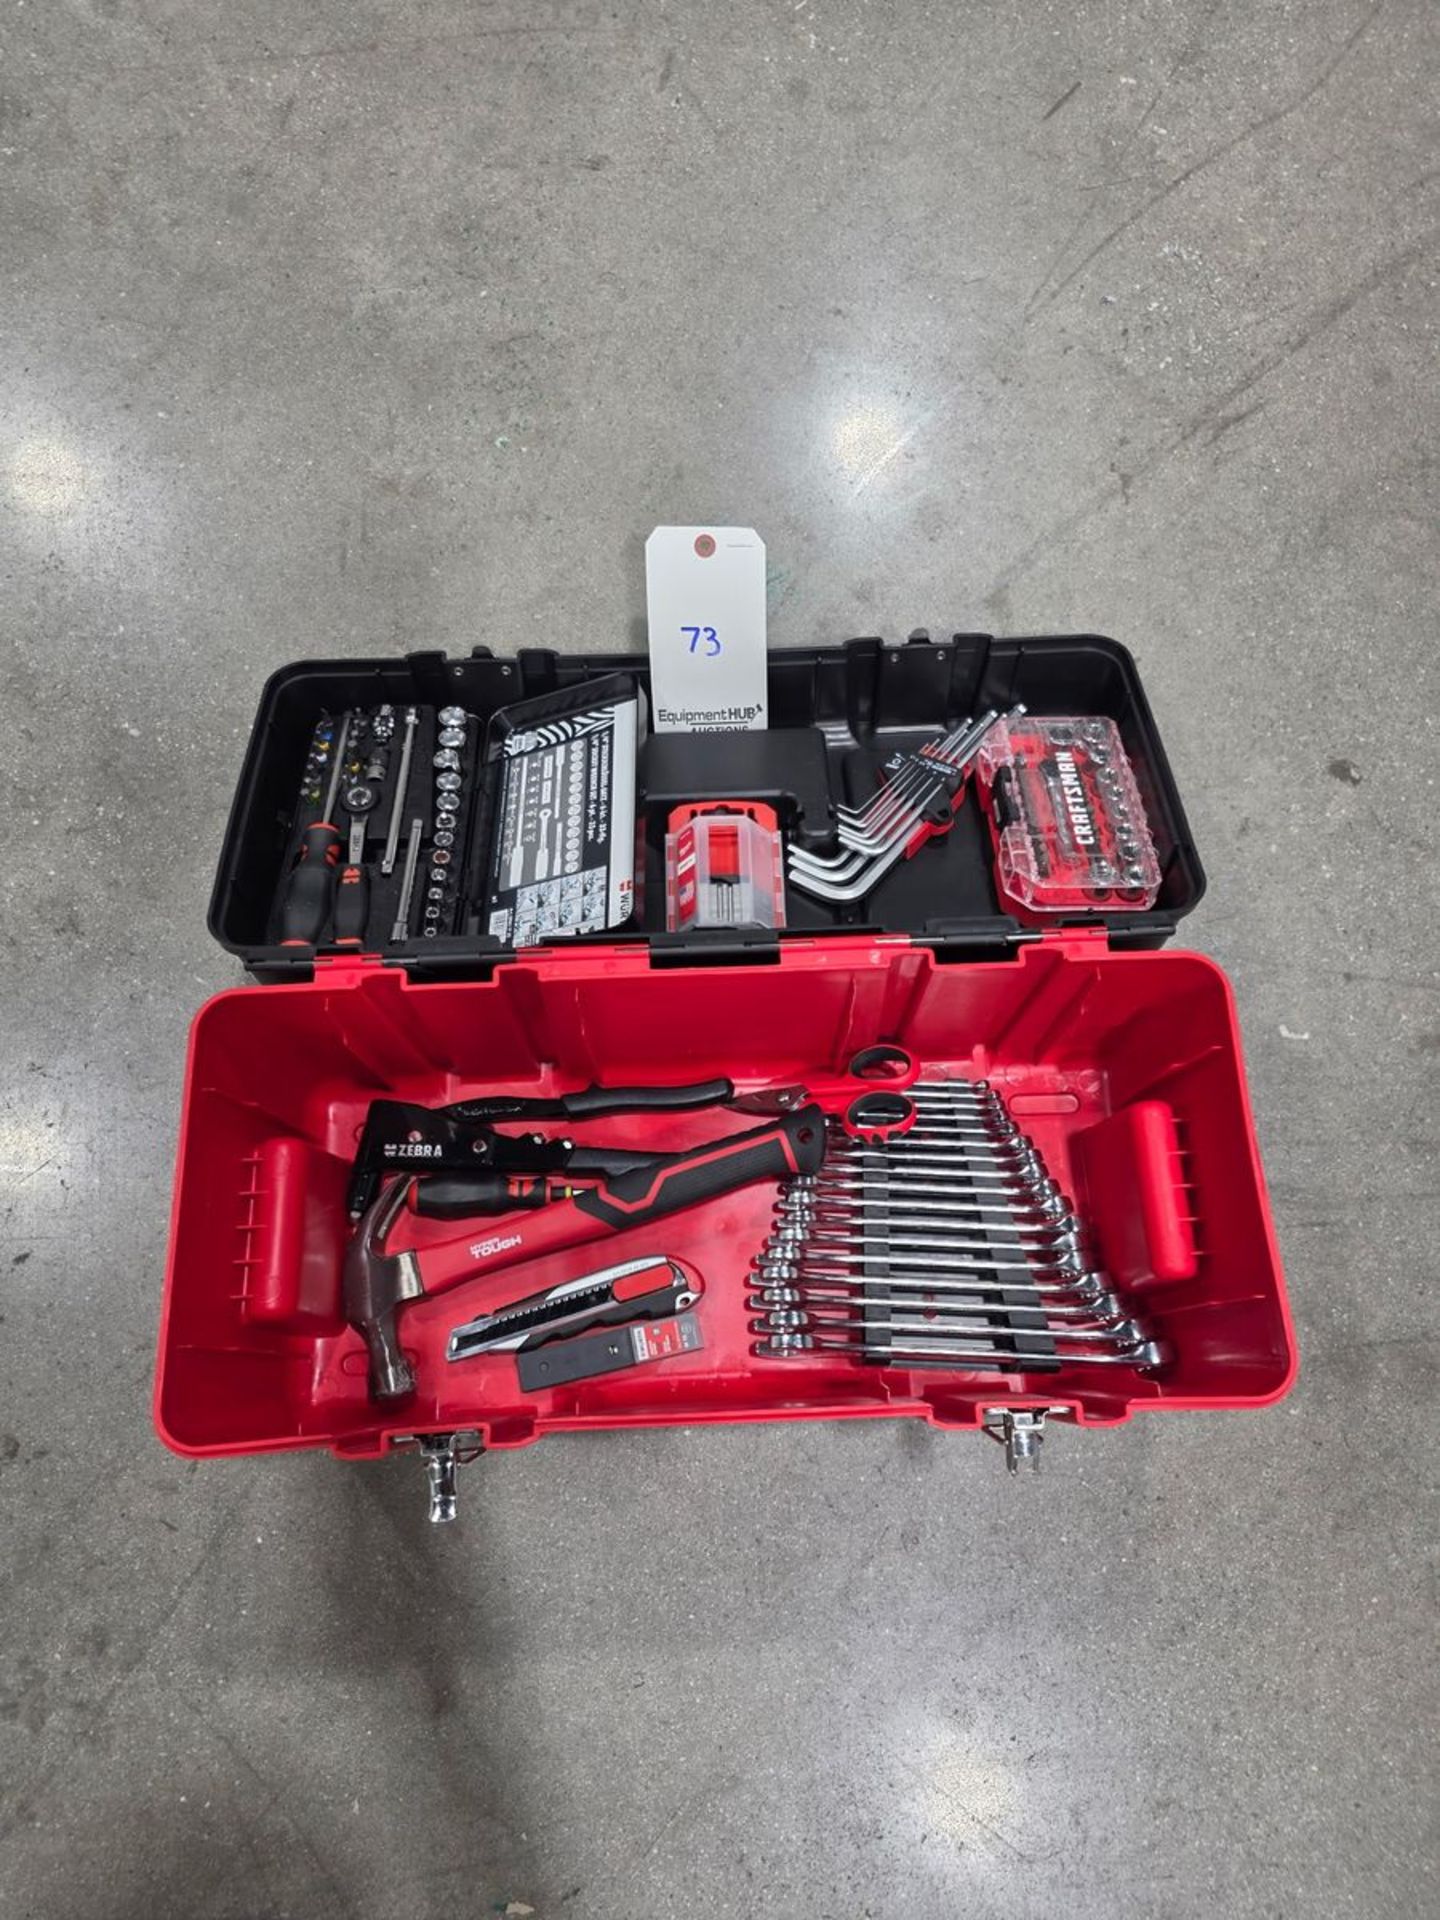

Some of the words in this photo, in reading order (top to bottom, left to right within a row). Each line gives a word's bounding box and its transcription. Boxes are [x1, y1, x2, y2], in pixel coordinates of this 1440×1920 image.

[680, 626, 721, 657] 73
[1055, 752, 1095, 845] CRAFTSMAN
[398, 1144, 443, 1157] ZEBRA
[472, 1234, 522, 1259] TOUGH
